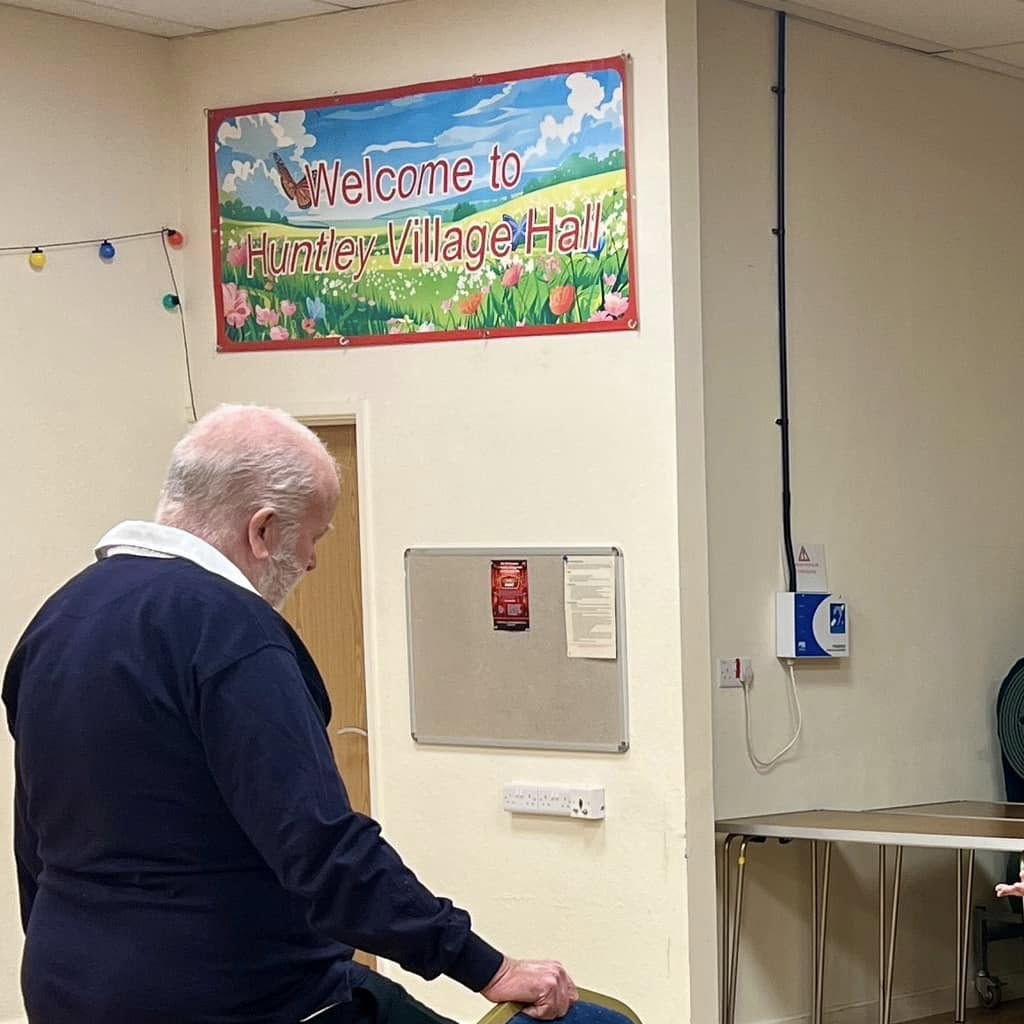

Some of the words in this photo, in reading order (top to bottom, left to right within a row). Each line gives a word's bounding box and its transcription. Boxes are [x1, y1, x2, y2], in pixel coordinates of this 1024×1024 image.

[305, 156, 474, 208] Welcome
[490, 145, 522, 190] to
[246, 227, 376, 281] Huntley
[387, 215, 513, 271] Village
[525, 203, 602, 254] Hall
